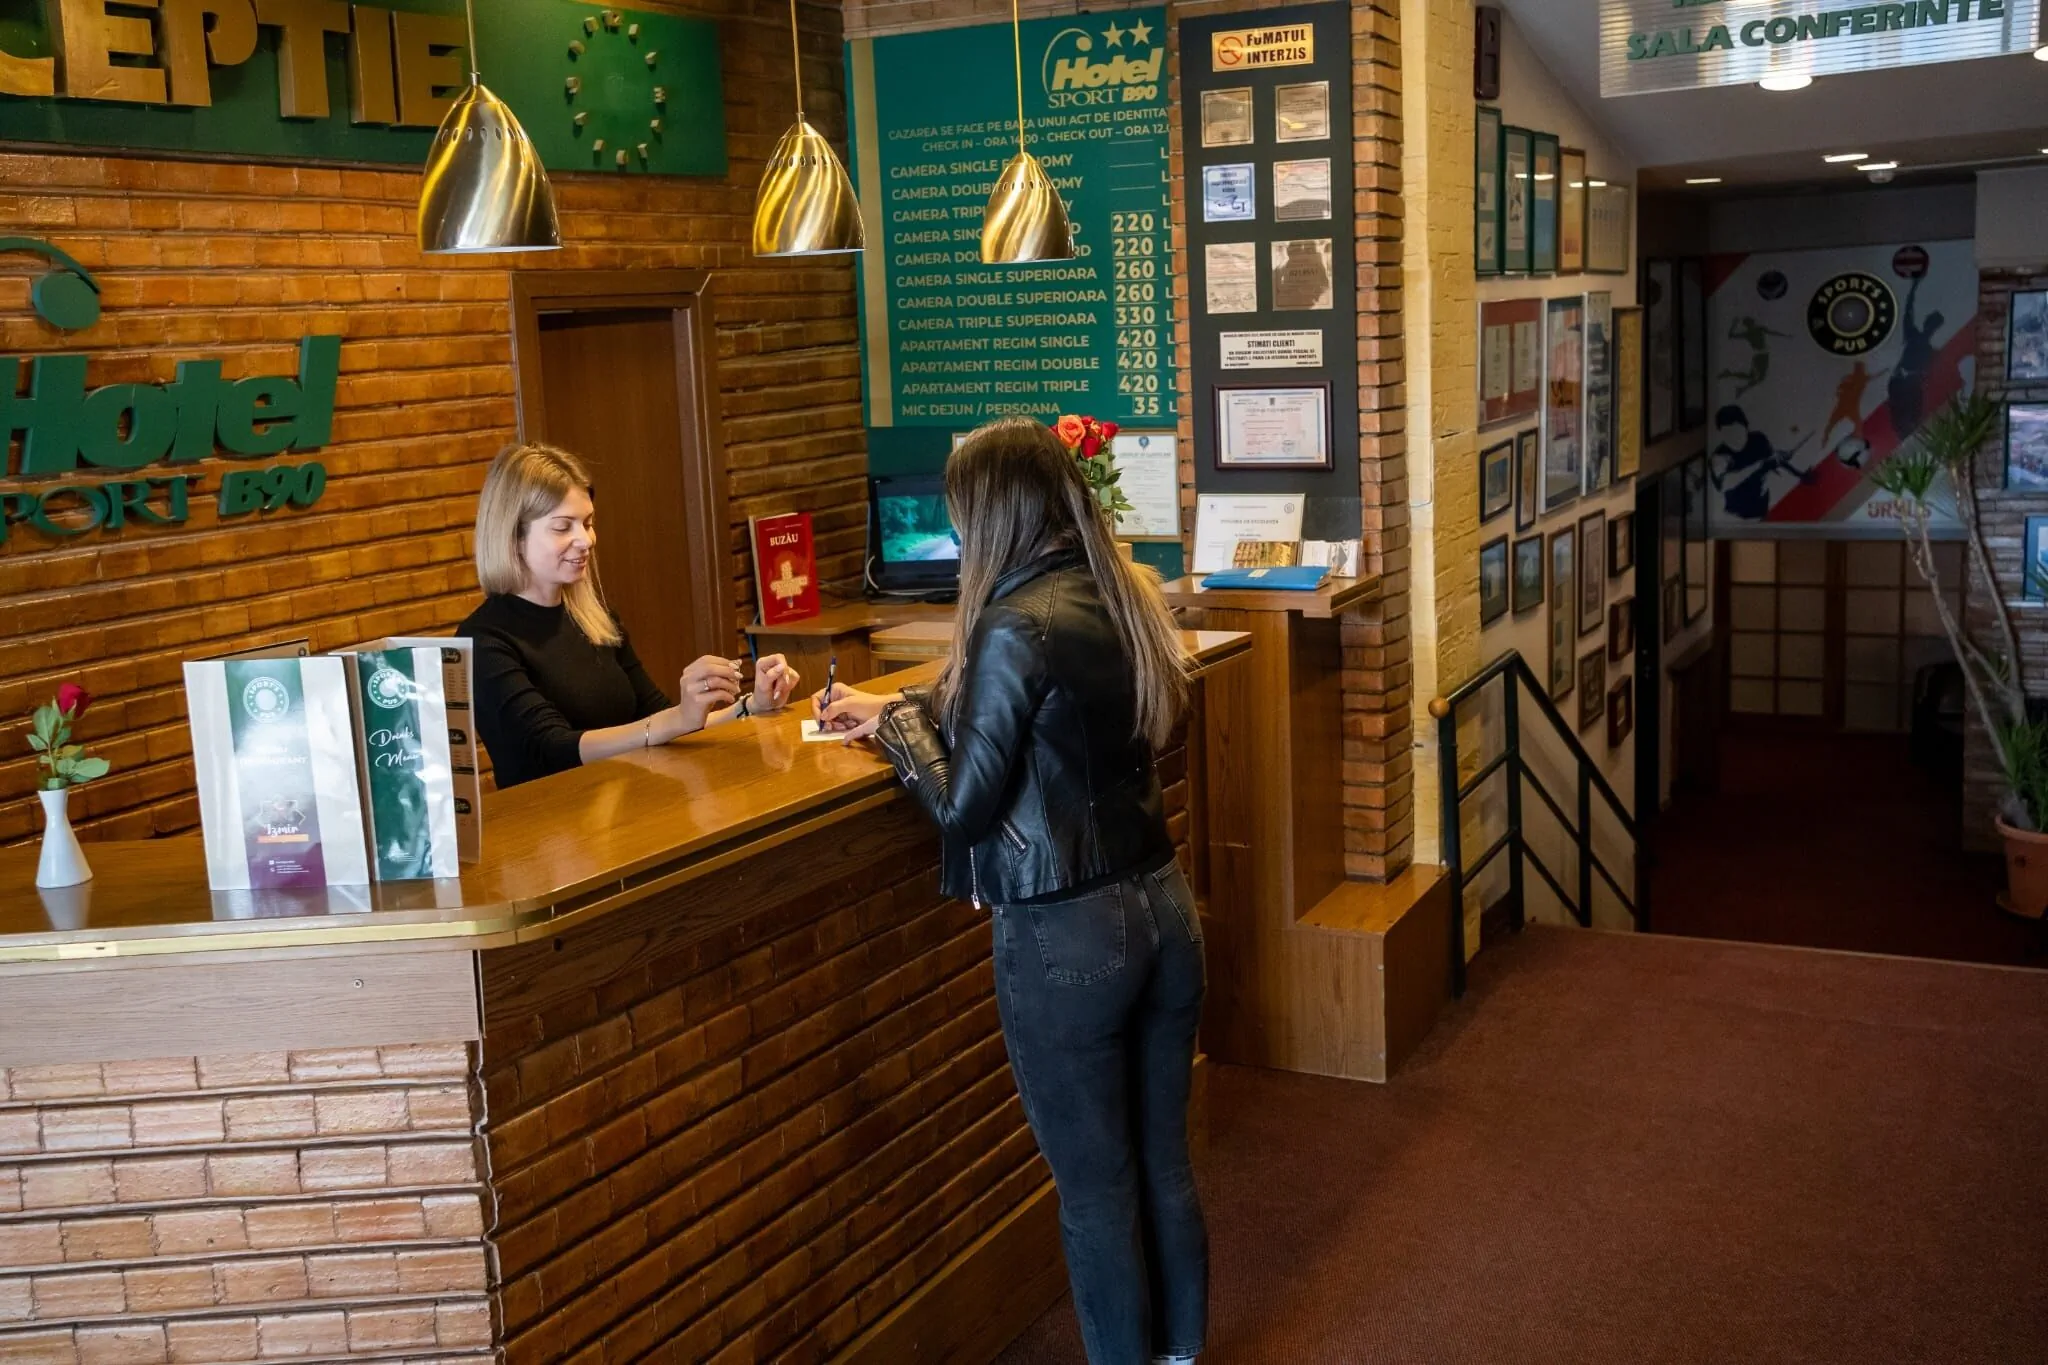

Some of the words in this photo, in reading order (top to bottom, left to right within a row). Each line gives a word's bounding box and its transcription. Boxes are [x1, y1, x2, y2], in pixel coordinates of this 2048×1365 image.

[1246, 28, 1306, 46] FUMATUL
[1626, 24, 1735, 60] SALA
[1740, 0, 2005, 47] CONFERINTE
[1247, 46, 1306, 64] INTERZIS
[1052, 47, 1164, 90] Hotel
[1047, 87, 1119, 108] SPORT
[1122, 84, 1157, 102] B90
[888, 127, 938, 140] CAZAREA
[940, 125, 954, 136] SE
[956, 122, 984, 134] FACE
[987, 121, 1002, 132] PE
[1037, 116, 1066, 128] UNUI
[1069, 114, 1091, 126] ACT
[1094, 112, 1110, 123] DE
[1113, 107, 1169, 121] IDENTITA
[922, 140, 960, 152] CHECK
[962, 138, 973, 149] IN
[984, 136, 1008, 147] ORA
[1047, 130, 1086, 142] CHECK
[1089, 128, 1113, 140] OUT
[1124, 125, 1150, 136] ORA
[890, 164, 946, 178] CAMERA
[950, 160, 998, 174] SINGLE
[892, 185, 948, 200] CAMERA
[952, 182, 996, 196] DOUB
[893, 207, 949, 222] CAMERA
[894, 229, 950, 244] CAMERA
[1114, 213, 1154, 232] 220
[895, 252, 952, 266] CAMERA
[1114, 236, 1154, 256] 220
[896, 274, 952, 288] CAMERA
[956, 272, 1004, 286] SINGLE
[1006, 268, 1097, 282] SUPERIOARA
[1116, 260, 1154, 280] 260
[898, 296, 952, 310] CAMERA
[956, 293, 1012, 308] DOUBLE
[1016, 288, 1107, 304] SUPERIOARA
[1116, 283, 1154, 302] 260
[1817, 277, 1883, 304] SPORTS
[898, 317, 954, 330] CAMERA
[958, 315, 1004, 328] TRIPLE
[1006, 312, 1097, 326] SUPERIOARA
[1116, 306, 1155, 325] 330
[900, 338, 990, 352] APARTAMENT
[992, 336, 1036, 349] REGIM
[1040, 335, 1090, 348] SINGLE
[1117, 329, 1156, 348] 420
[1833, 337, 1868, 352] PUB
[901, 360, 990, 373] APARTAMENT
[994, 358, 1038, 371] REGIM
[1042, 356, 1099, 370] DOUBLE
[1118, 350, 1158, 369] 420
[902, 381, 992, 394] APARTAMENT
[995, 380, 1038, 393] REGIM
[1042, 379, 1090, 392] TRIPLE
[1120, 374, 1158, 393] 420
[902, 404, 926, 416] MIC
[930, 403, 974, 416] DEJUN
[986, 402, 1060, 415] PERSOANA
[1134, 396, 1159, 415] 35
[218, 462, 327, 516] B90
[368, 726, 414, 746] Drinks
[375, 748, 420, 767] Menu
